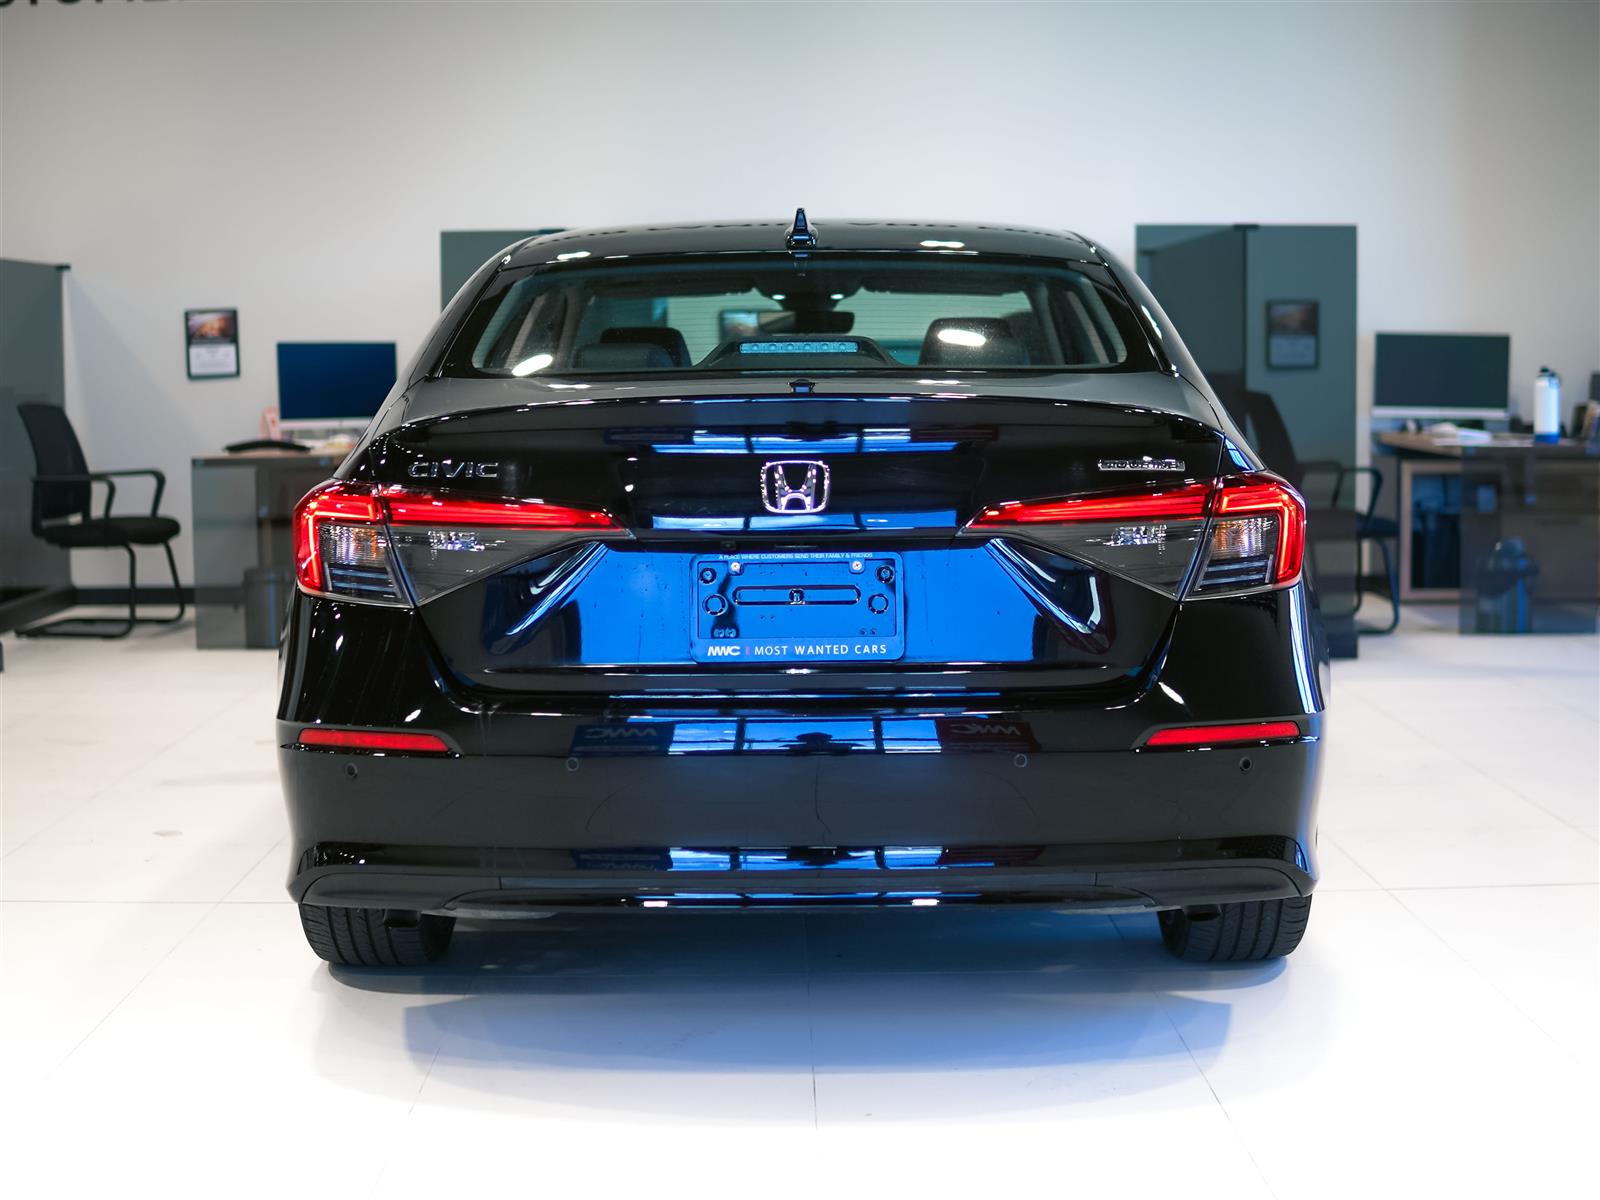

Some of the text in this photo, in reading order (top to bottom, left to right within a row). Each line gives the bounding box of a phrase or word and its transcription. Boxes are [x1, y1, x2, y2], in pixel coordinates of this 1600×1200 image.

[408, 460, 498, 477] CIVIC
[754, 645, 788, 656] MOST
[794, 644, 849, 655] WANTED
[854, 644, 887, 654] CARS
